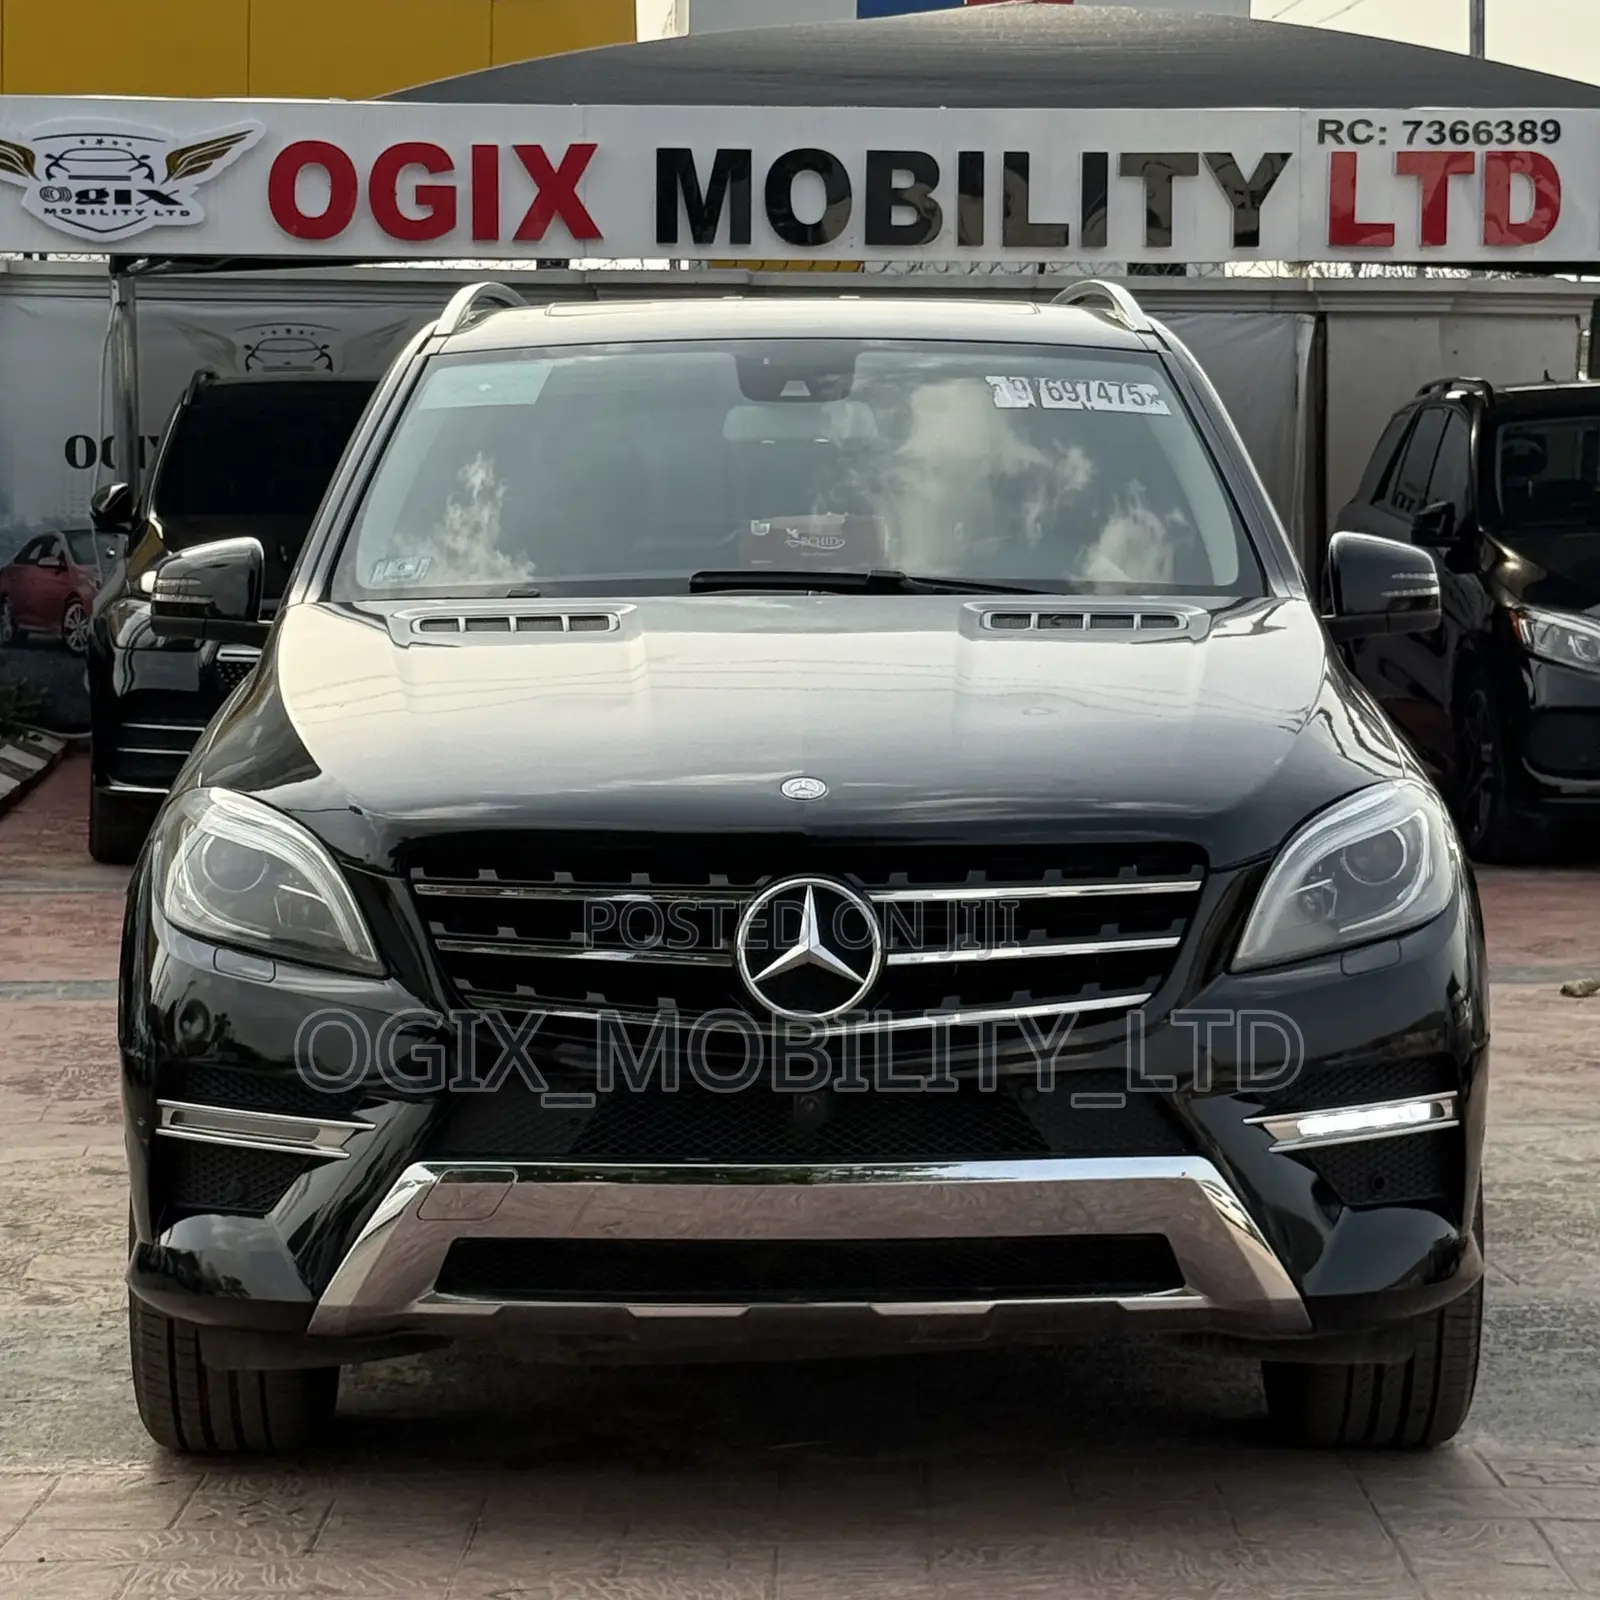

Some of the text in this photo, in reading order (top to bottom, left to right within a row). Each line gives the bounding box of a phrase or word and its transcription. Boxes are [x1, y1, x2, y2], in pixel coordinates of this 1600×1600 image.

[1317, 119, 1562, 146] RC: 7366389
[267, 140, 1562, 248] OGIX MOBILITY LTD
[43, 207, 192, 217] MOBILITY LTD
